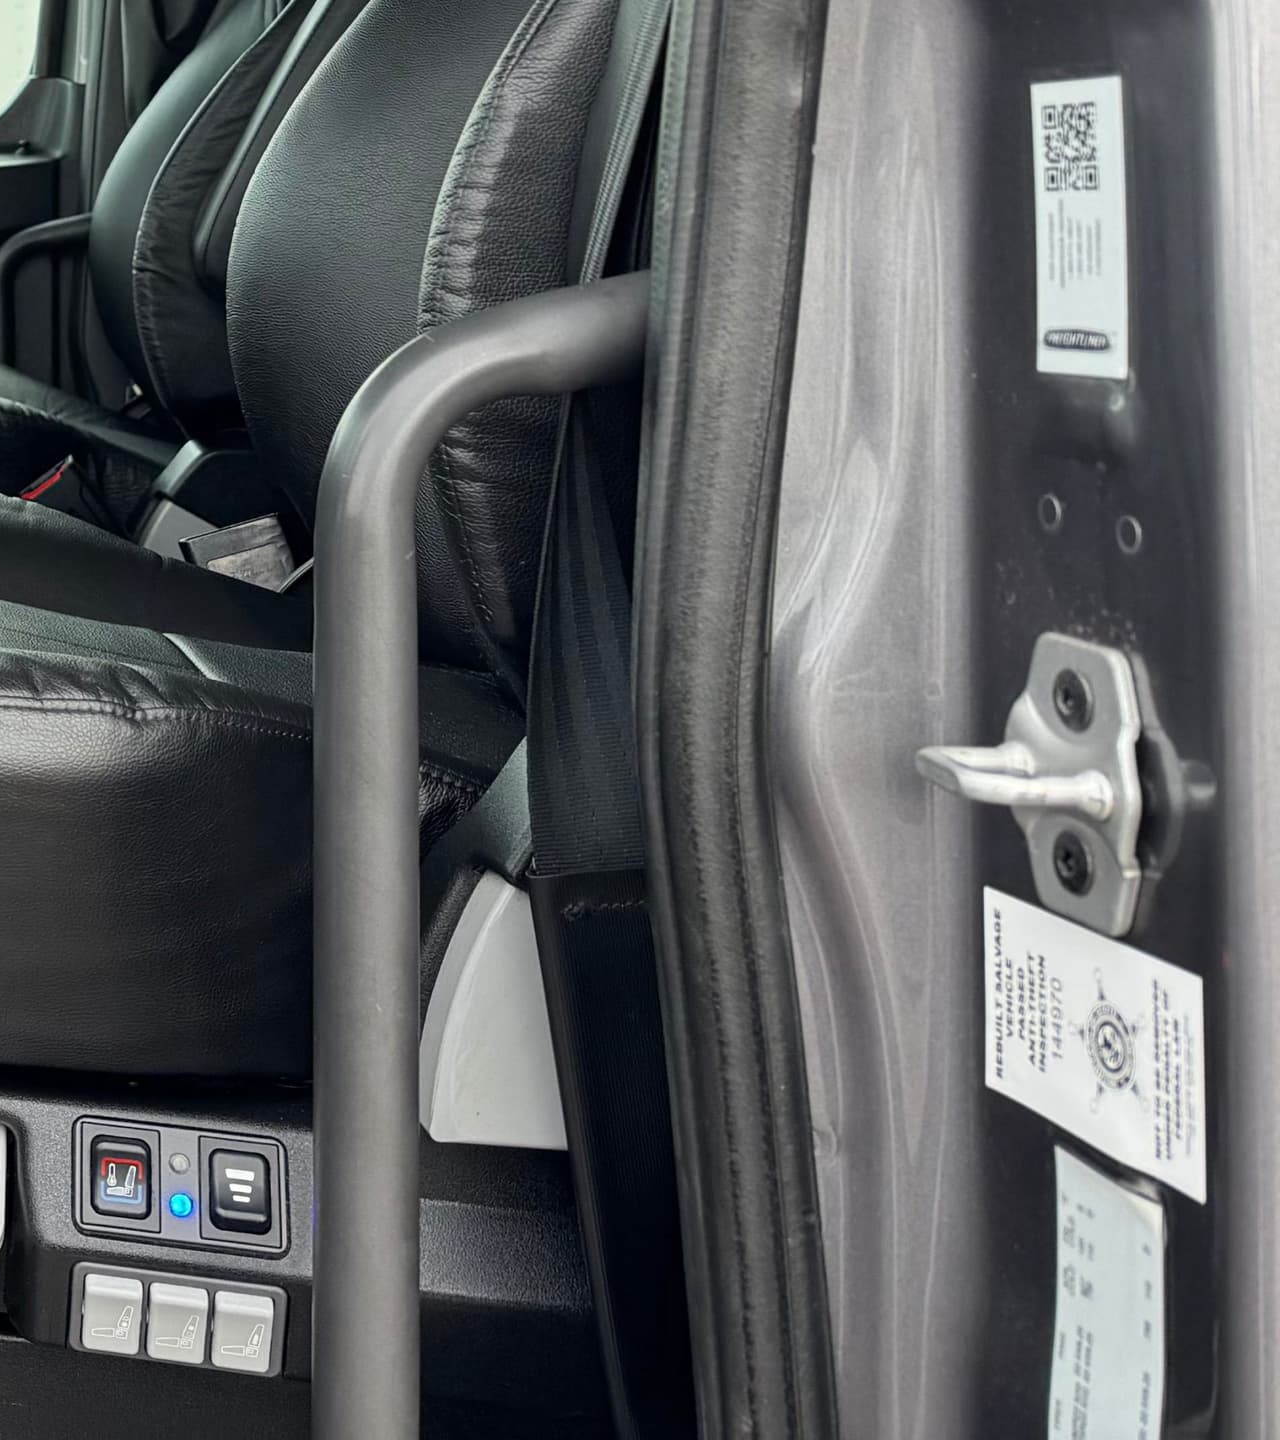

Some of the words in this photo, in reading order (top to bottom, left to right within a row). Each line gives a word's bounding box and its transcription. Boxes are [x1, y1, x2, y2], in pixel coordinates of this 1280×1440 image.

[993, 907, 1002, 993] SALVAGE
[995, 999, 1003, 1079] REBUILT
[1005, 957, 1014, 1038] VEHICLE
[1017, 966, 1025, 1040] PASSED
[1027, 951, 1036, 1066] ANTI-THEFT
[1037, 953, 1046, 1073] INSPECTION
[1049, 977, 1063, 1060] 144970
